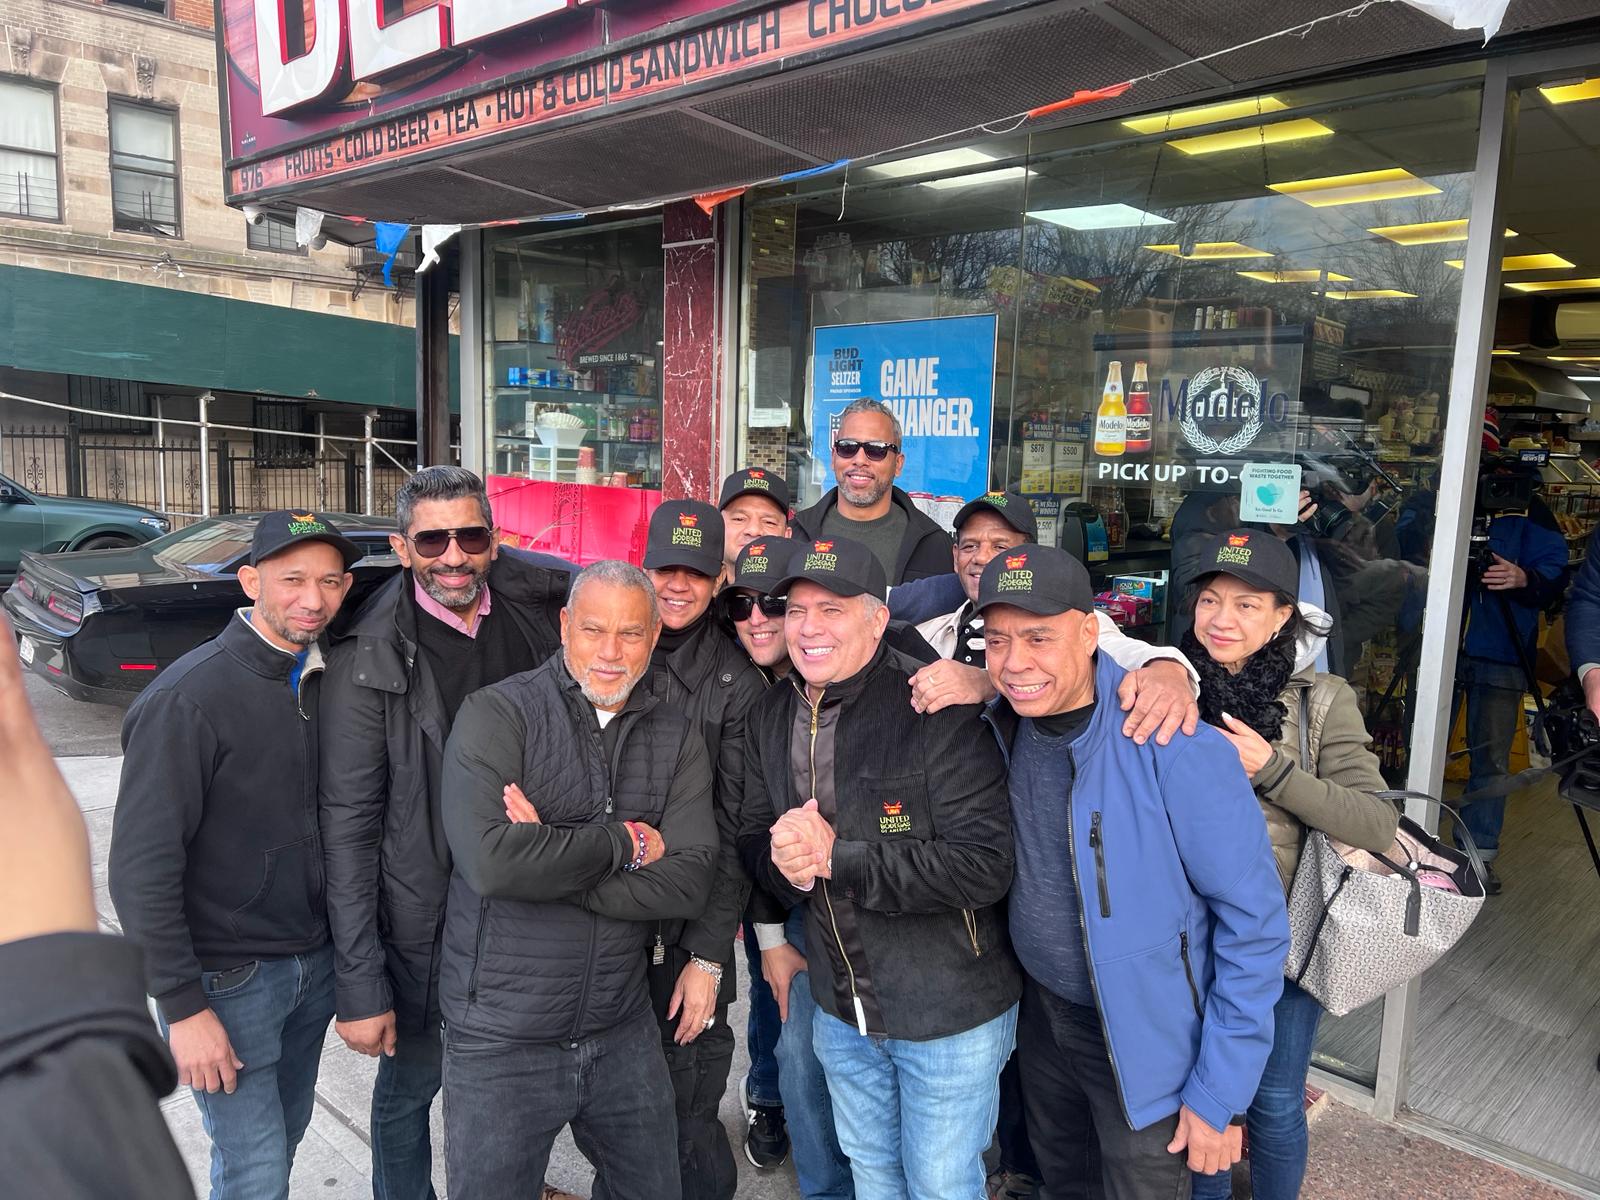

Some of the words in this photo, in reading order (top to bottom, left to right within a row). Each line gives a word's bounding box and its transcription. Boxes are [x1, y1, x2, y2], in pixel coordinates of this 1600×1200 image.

[240, 163, 263, 191] 976
[285, 143, 334, 179] FRUITS
[343, 126, 383, 162] COLD
[387, 110, 430, 152] BEER
[442, 99, 479, 136] TEA
[497, 83, 537, 123] HOT
[543, 78, 557, 110] &
[562, 56, 624, 105] COLD
[630, 9, 781, 89] SANDWICH
[833, 347, 860, 359] BUD
[580, 355, 599, 364] BREWED
[600, 354, 614, 363] SINCE
[829, 360, 864, 372] LIGHT
[831, 371, 861, 386] SELTZER
[880, 357, 940, 397] GAME
[1158, 377, 1290, 424] Modelo
[1100, 420, 1124, 430] Modelo
[1098, 462, 1150, 481] PICK
[1154, 464, 1187, 482] UP
[743, 478, 769, 486] UNITED
[673, 527, 702, 537] UNITED
[1219, 546, 1252, 556] UNITED
[745, 556, 769, 565] UNITED
[806, 552, 837, 561] UNITED
[805, 559, 836, 567] BODEGAS
[998, 569, 1033, 582] UNITED
[998, 578, 1033, 588] BODEGAS
[879, 815, 910, 824] UNITED
